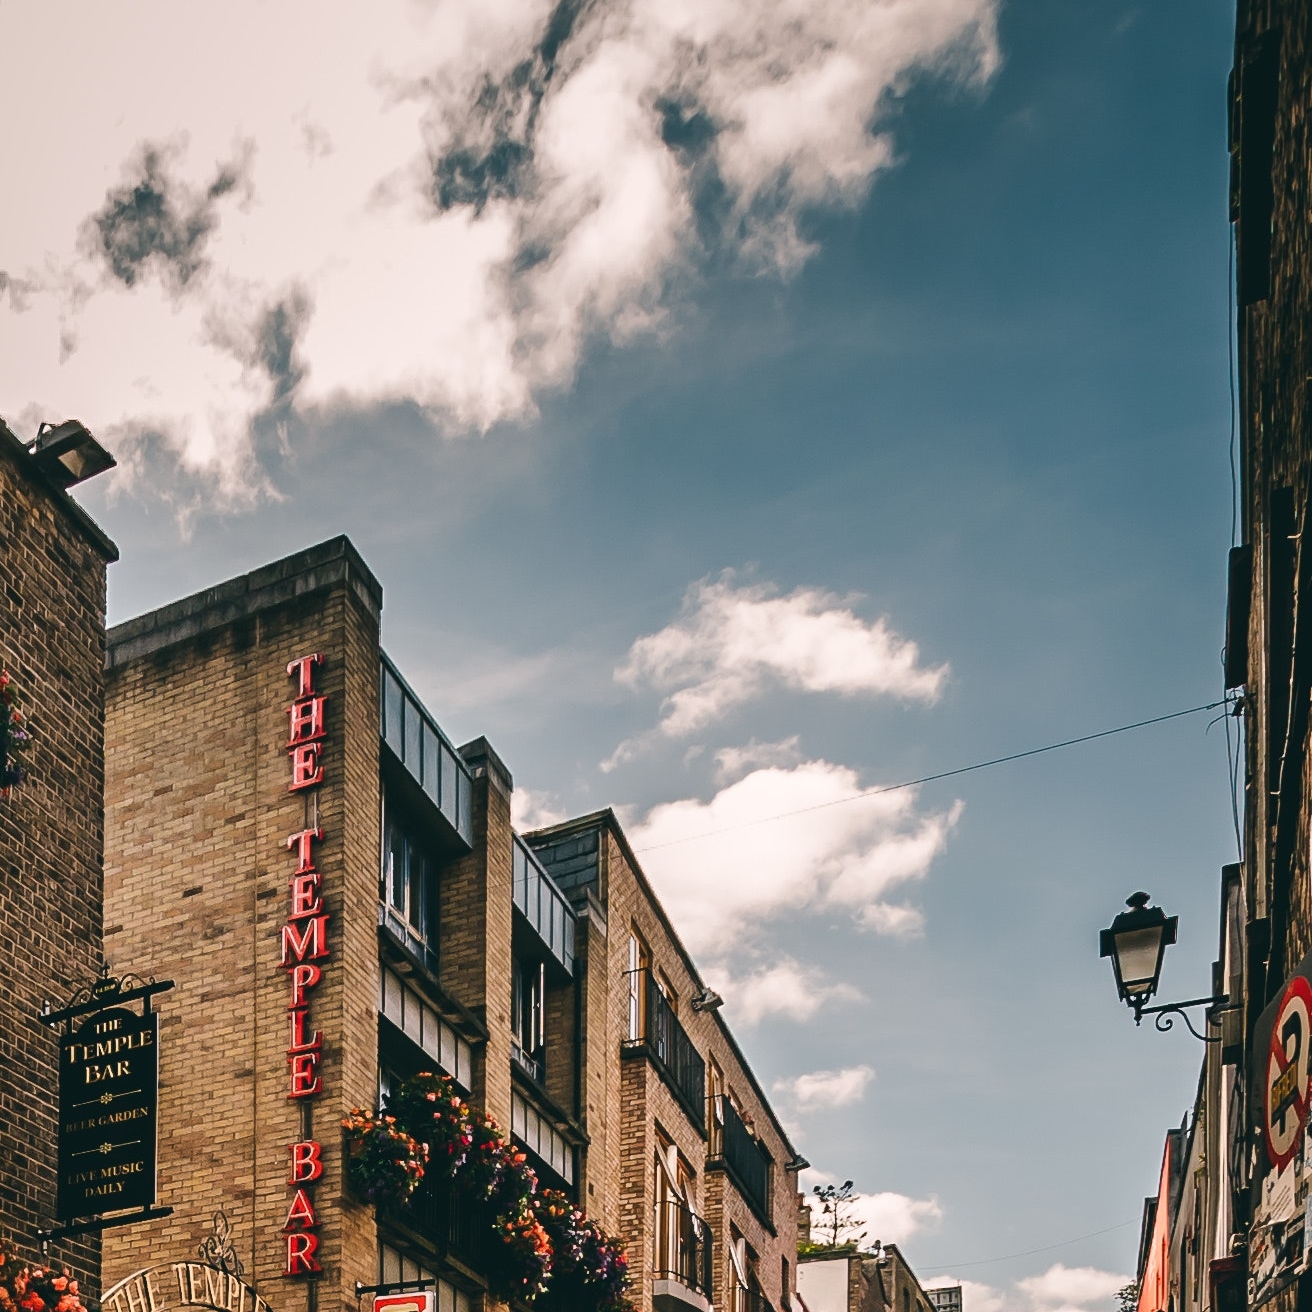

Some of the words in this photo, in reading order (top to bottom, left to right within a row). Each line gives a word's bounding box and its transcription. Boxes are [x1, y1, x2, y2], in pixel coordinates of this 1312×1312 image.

[286, 653, 327, 792] THE
[279, 828, 330, 1099] TEMPLE
[94, 1018, 123, 1035] THE
[65, 1030, 152, 1064] TEMPLE
[85, 1060, 131, 1084] BAR
[66, 1117, 95, 1133] BEER
[98, 1107, 149, 1126] GARDEN
[68, 1171, 97, 1185] LIVE
[101, 1161, 144, 1178] MUSIC
[85, 1181, 126, 1197] DAILY
[282, 1140, 323, 1275] BAR
